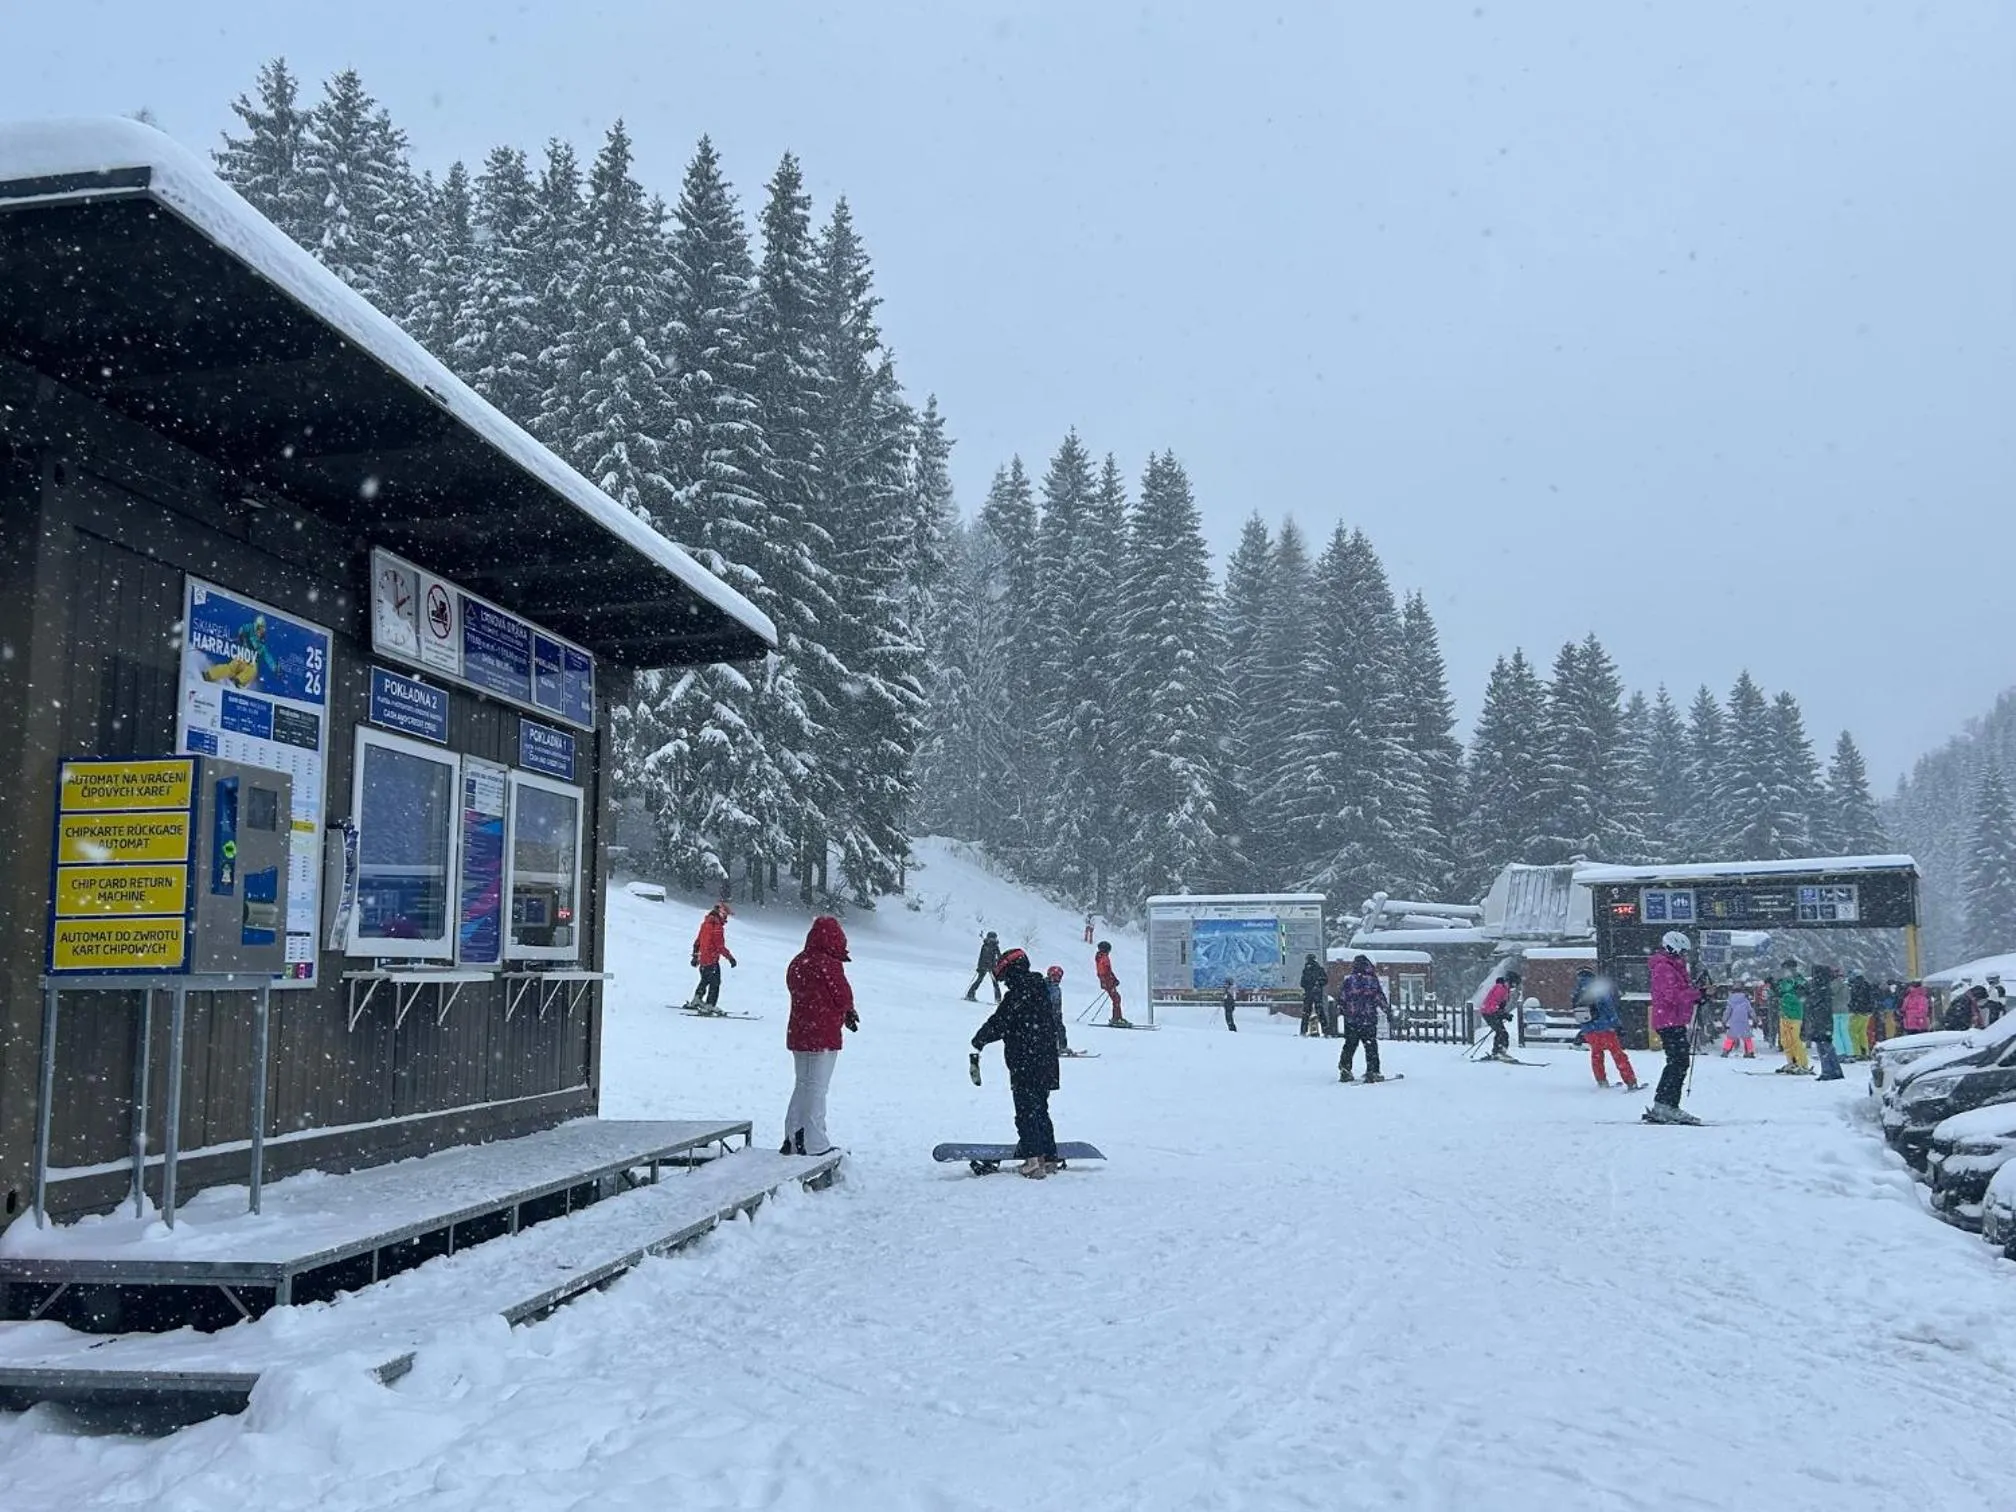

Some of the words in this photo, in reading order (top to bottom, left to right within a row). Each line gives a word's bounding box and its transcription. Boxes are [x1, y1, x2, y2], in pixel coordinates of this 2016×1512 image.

[192, 631, 258, 664] HARRACHOV
[306, 646, 323, 671] 25
[304, 671, 321, 696] 26
[384, 678, 431, 707] POKLADNA
[431, 695, 438, 709] 2
[68, 774, 120, 786] AUTOMAT
[121, 773, 139, 785] NA
[136, 785, 172, 797] KARET
[65, 826, 124, 838] CHIPKARTE
[127, 823, 184, 836] RÜCKGABE
[98, 838, 150, 849] AUTOMAT
[71, 878, 97, 890] CHIP
[99, 877, 128, 889] CARD
[130, 876, 173, 888] RETURN
[98, 890, 146, 902] MACHINE
[61, 931, 113, 943] AUTOMAT
[115, 930, 132, 942] DO
[134, 929, 179, 941] ZWROTU
[72, 944, 101, 956] KART
[103, 943, 167, 955] CHIPOWYCH
